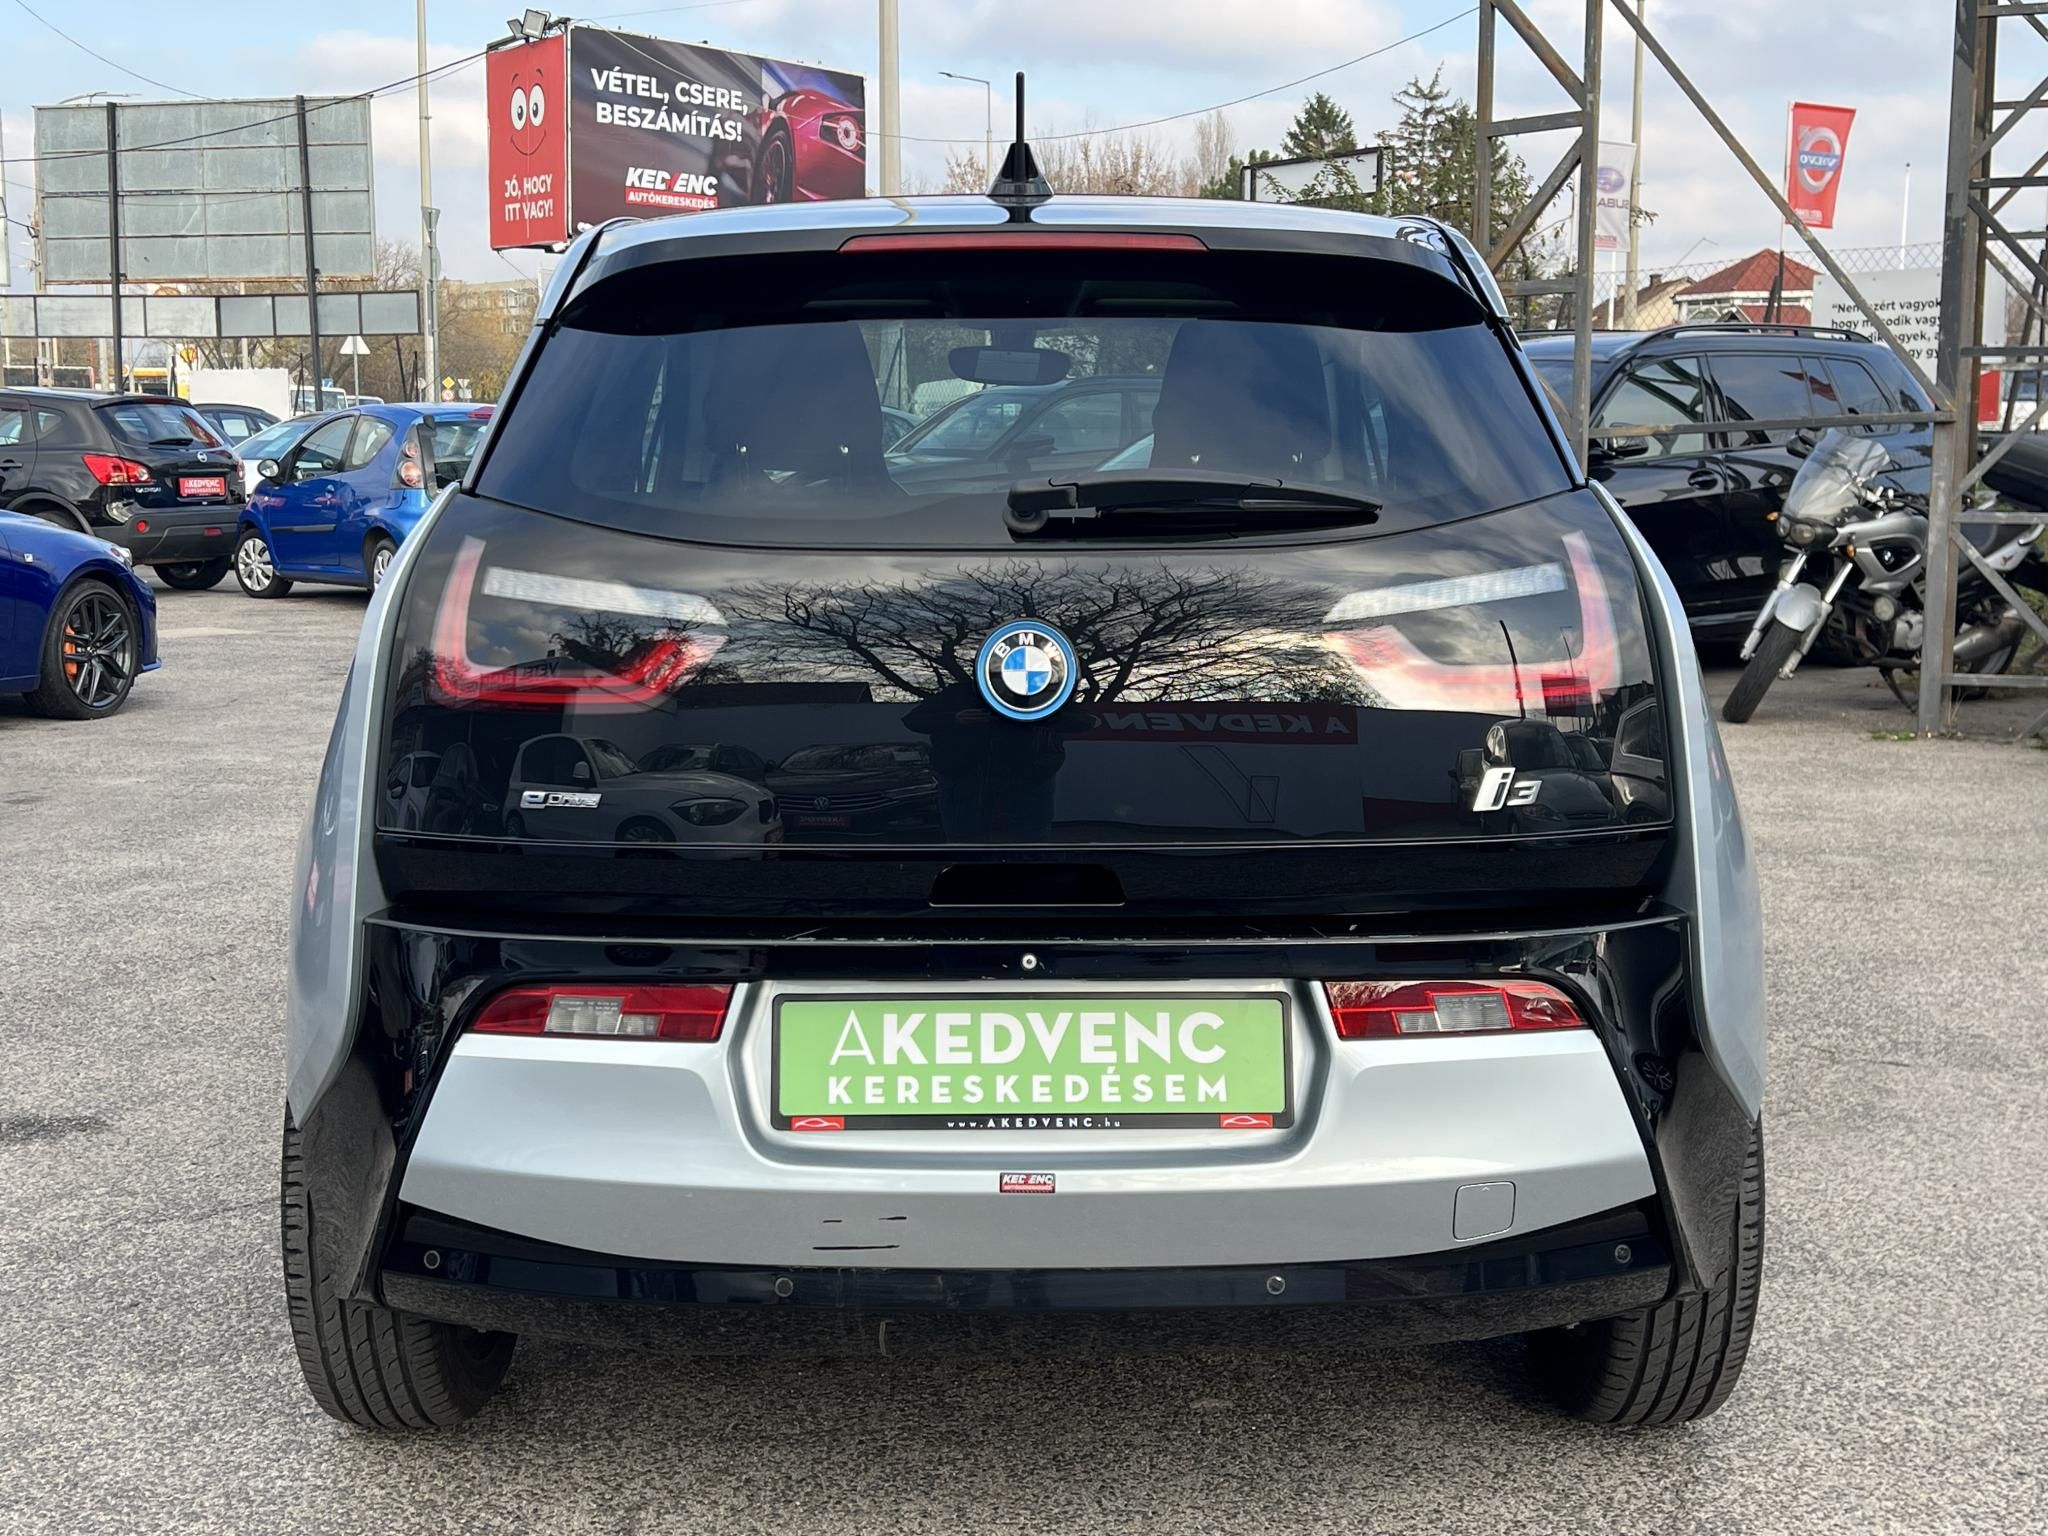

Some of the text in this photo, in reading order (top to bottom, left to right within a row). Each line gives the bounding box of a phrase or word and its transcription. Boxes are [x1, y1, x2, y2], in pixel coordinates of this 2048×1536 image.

[591, 66, 748, 115] VÉTEL, CSERE,
[596, 101, 742, 142] BESZÁMÍTÁS!
[504, 173, 553, 199] JÓ, HOGY
[628, 191, 716, 210] AUTÓKERESKEDÉS
[505, 198, 554, 222] ITT VAGY!
[1871, 301, 1896, 311] zért
[994, 632, 1062, 662] BMW
[1473, 767, 1542, 812] i3
[829, 1008, 1228, 1066] AKEDVENC
[828, 1066, 1228, 1105] KERESKEDÉSEM
[947, 1117, 1121, 1130] www.AKEDVENC.hu
